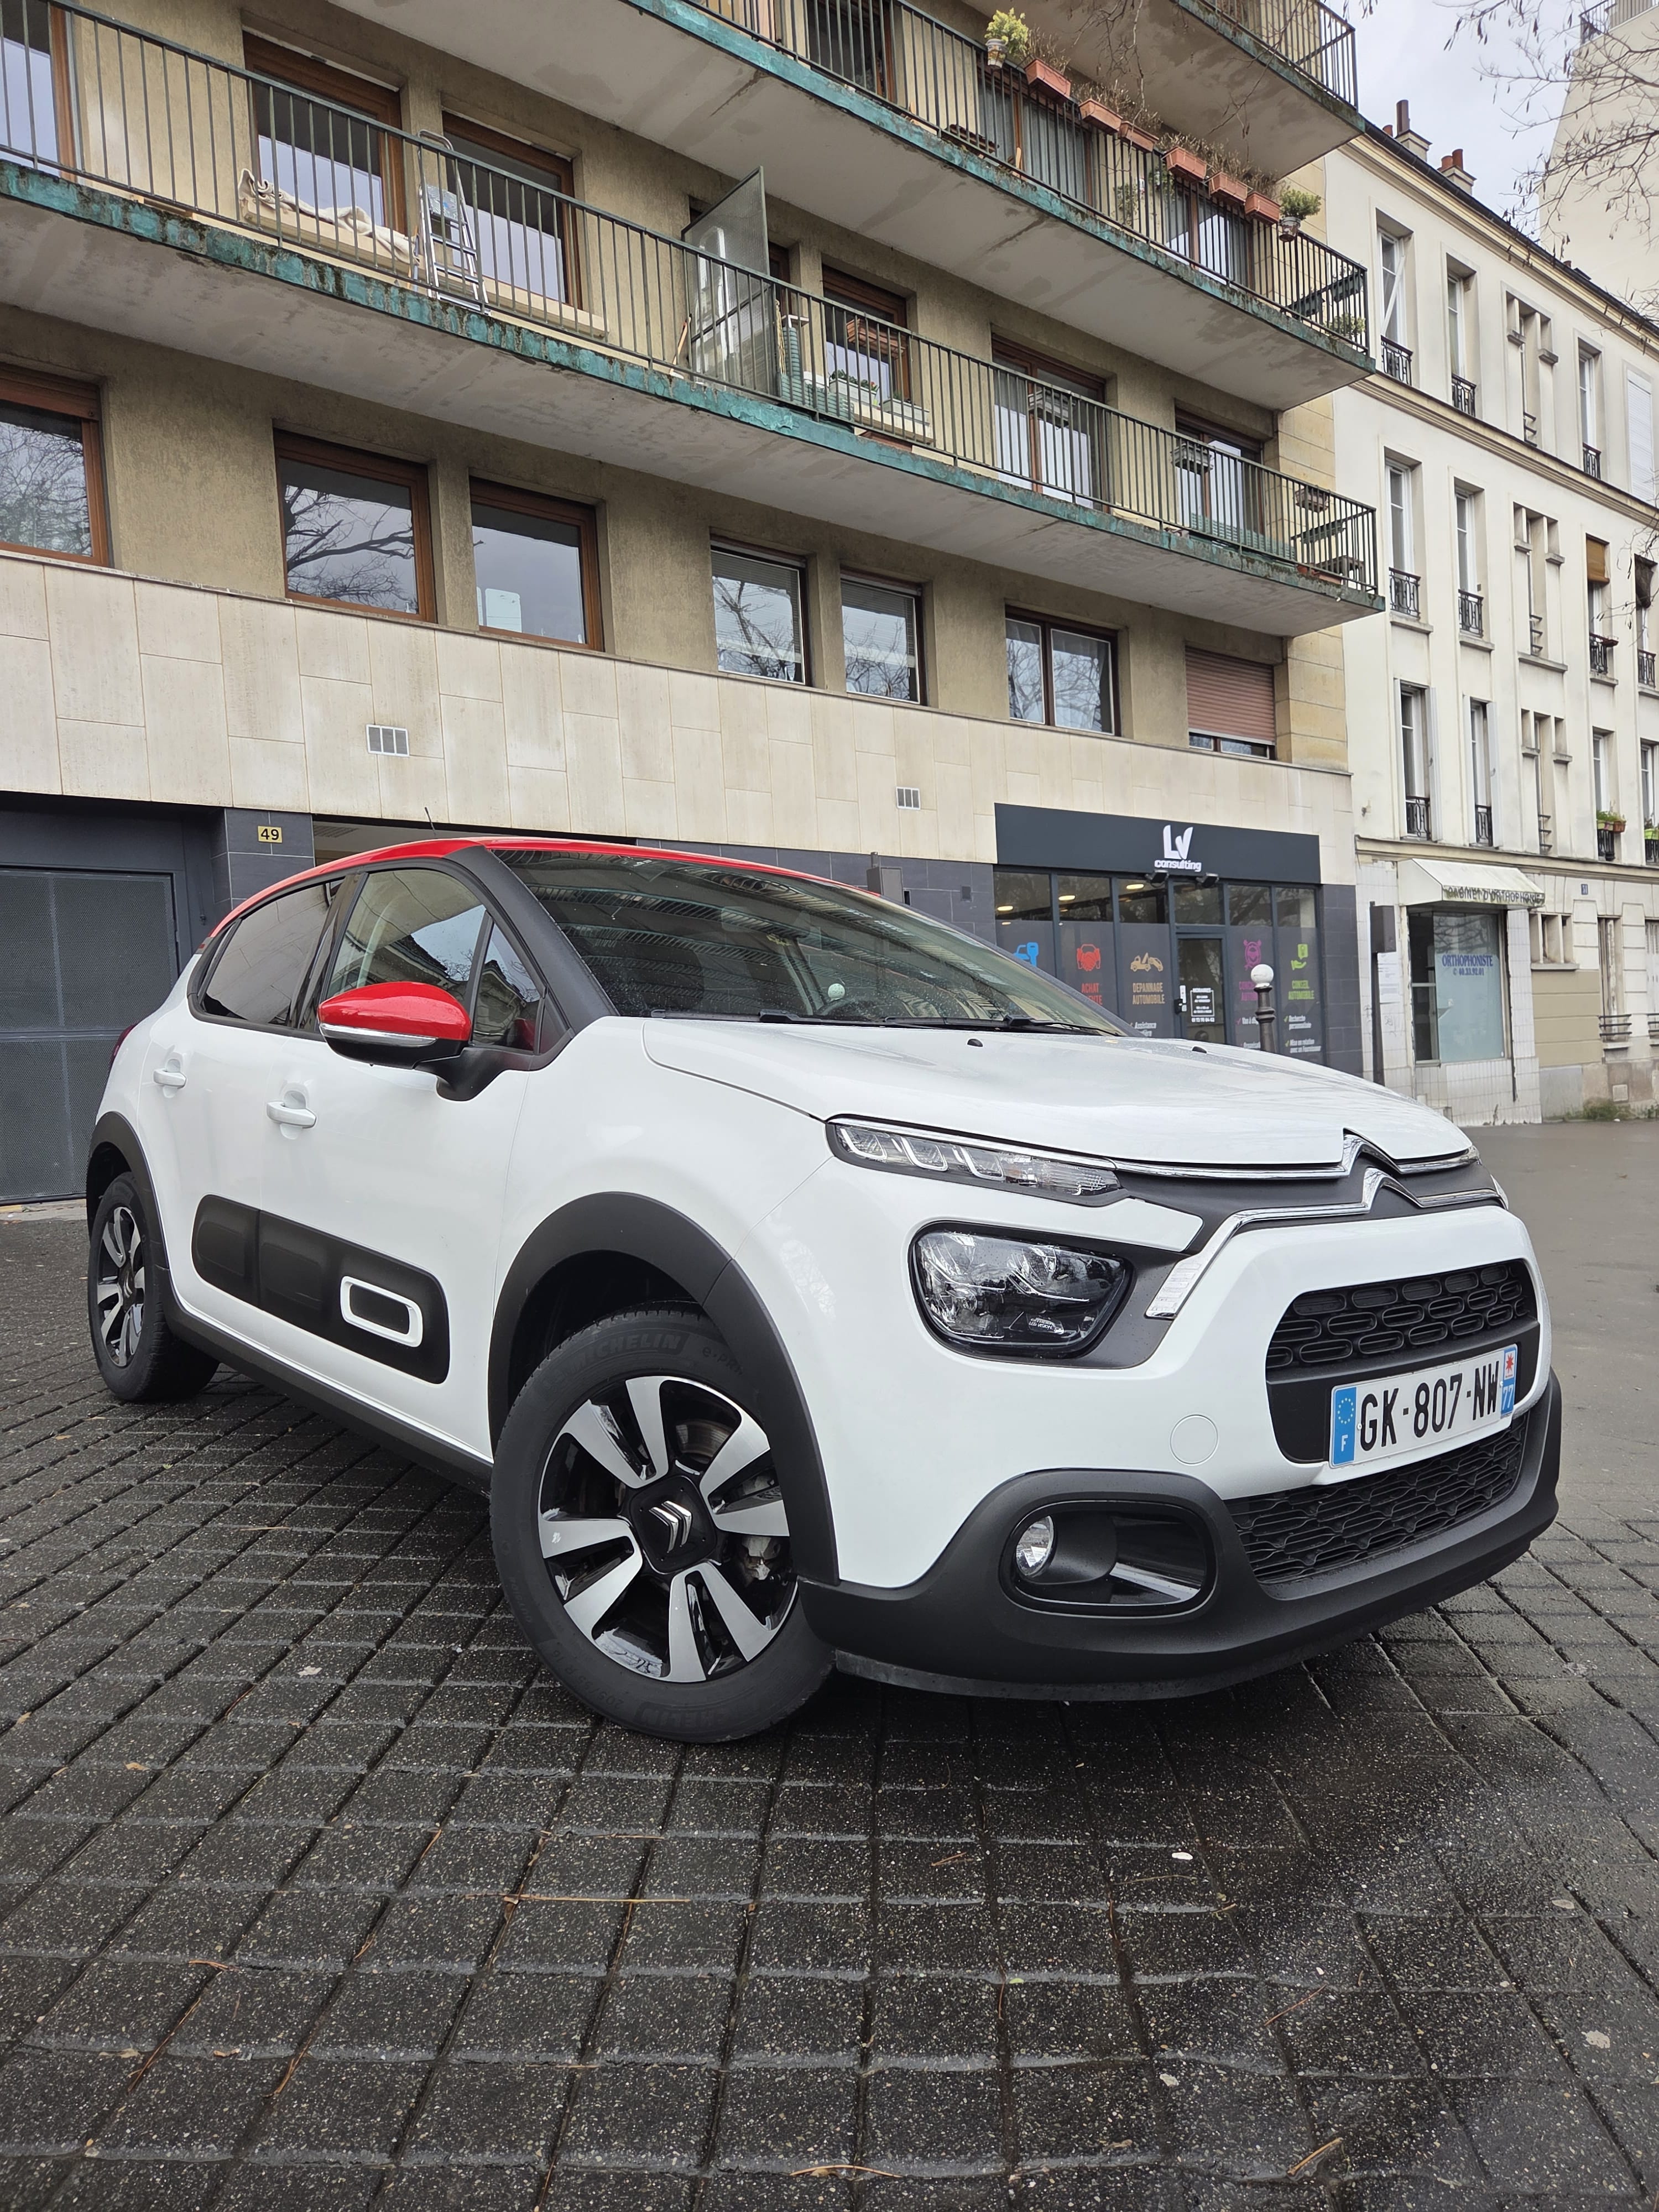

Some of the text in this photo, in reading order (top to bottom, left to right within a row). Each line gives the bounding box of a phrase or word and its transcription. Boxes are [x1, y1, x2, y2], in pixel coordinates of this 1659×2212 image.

[260, 828, 279, 841] 49
[1154, 860, 1202, 872] consulting
[1448, 886, 1481, 900] CABINET
[1442, 954, 1493, 967] ORTHOPHONISTE
[1081, 983, 1099, 993] ACHAT
[1133, 982, 1164, 993] DEPANNAGE
[1132, 994, 1165, 1005] AUTOMOBILE
[1502, 1384, 1514, 1411] 77
[1360, 1360, 1500, 1452] GK-807-NW
[1340, 1434, 1348, 1452] F
